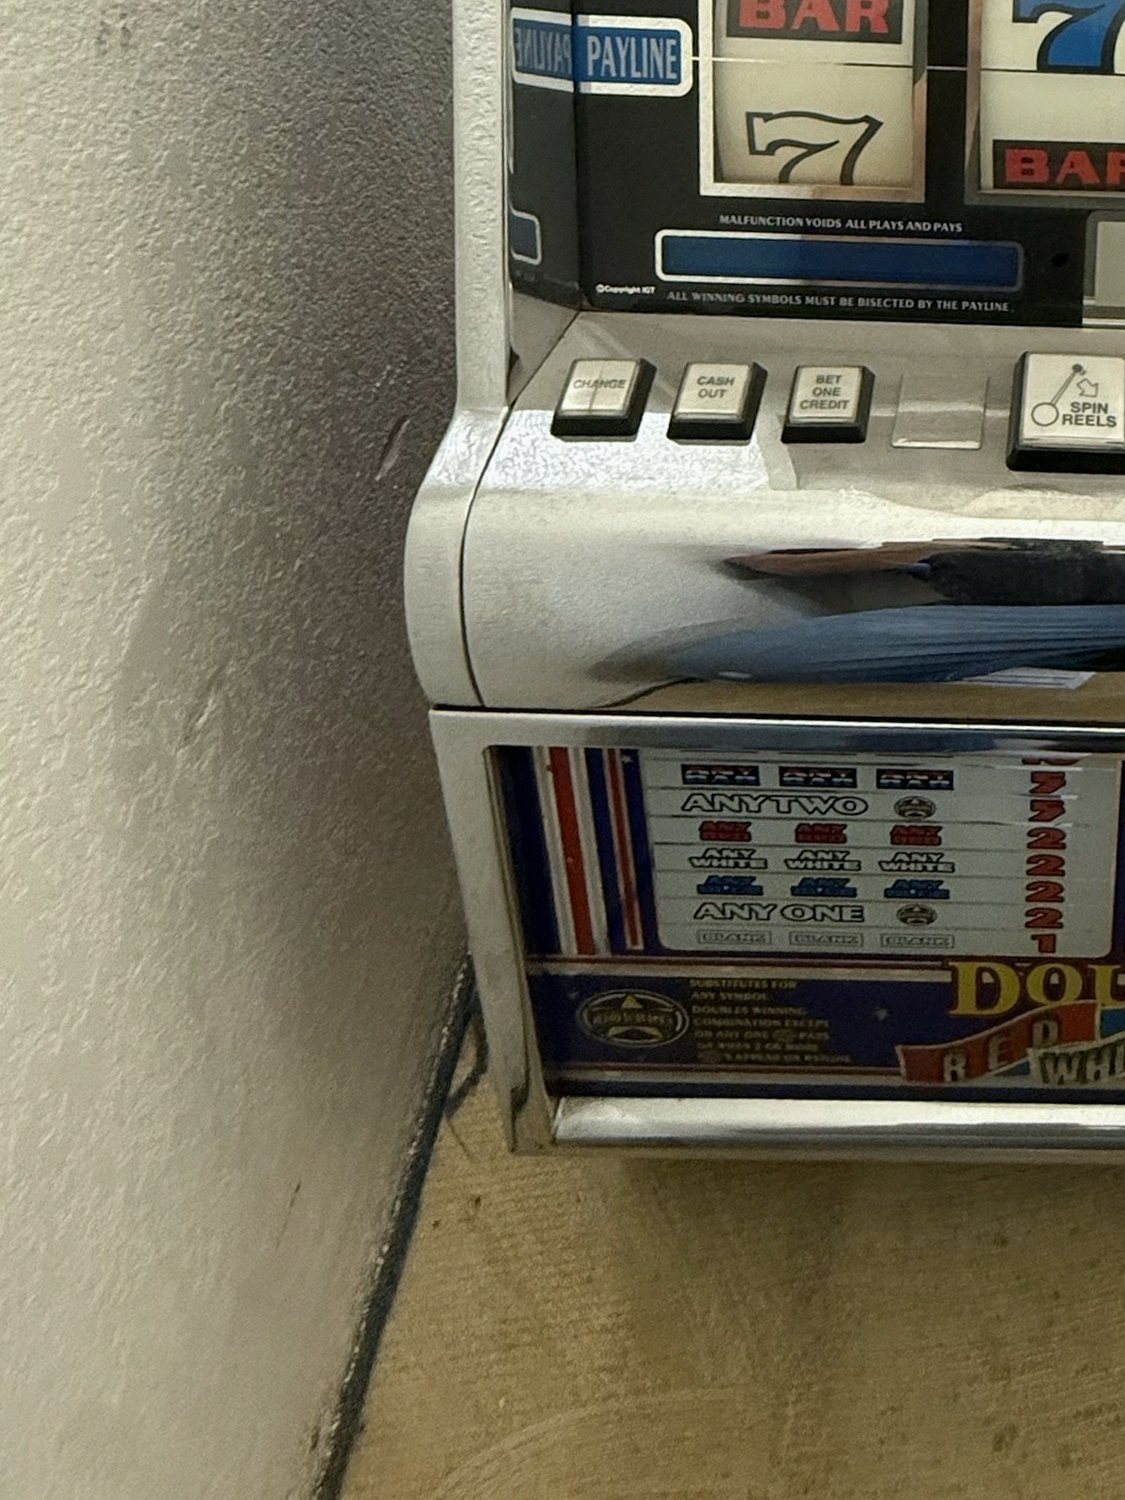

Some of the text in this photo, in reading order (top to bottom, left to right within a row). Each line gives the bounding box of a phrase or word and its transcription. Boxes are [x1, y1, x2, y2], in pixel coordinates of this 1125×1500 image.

[587, 35, 678, 80] PAYLINE
[746, 111, 883, 186] 7
[719, 214, 963, 234] MALFUNCTION VOIDS ALL PLAYS AND PAYS
[667, 290, 689, 301] ALL
[692, 292, 745, 304] WINNING
[747, 294, 802, 306] SYMBOLS
[804, 295, 837, 307] MUST
[839, 296, 854, 307] BE
[857, 297, 914, 309] BISECTED
[917, 299, 934, 310] BY
[936, 299, 959, 311] THE
[573, 379, 627, 390] CHANGE
[696, 376, 735, 387] CASH
[815, 374, 843, 385] BET
[698, 388, 727, 399] OUT
[812, 386, 841, 397] ONE
[801, 398, 849, 410] CREDIT
[1070, 402, 1108, 414] SPIN
[1062, 414, 1117, 427] REELS
[1027, 827, 1066, 849] 2
[694, 902, 1063, 929] ANY ONE 2
[942, 1018, 1059, 1084] RED
